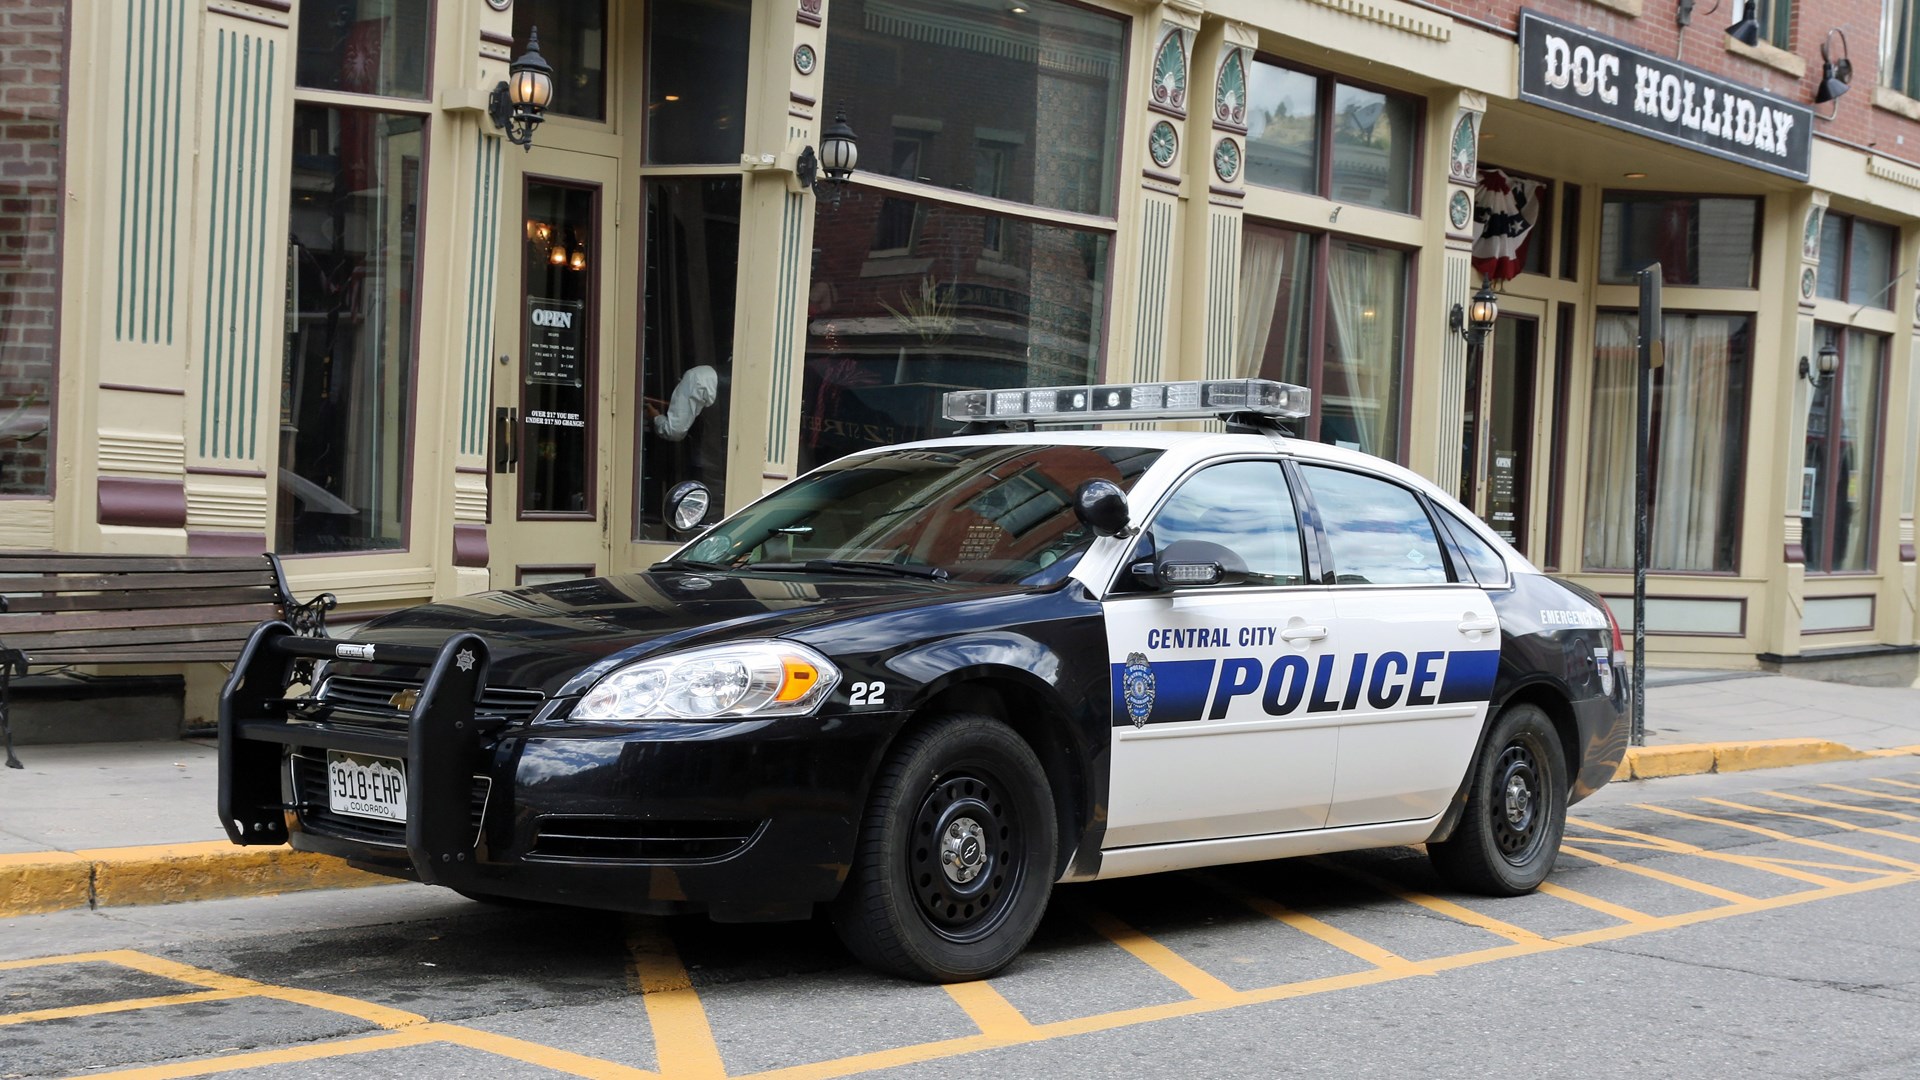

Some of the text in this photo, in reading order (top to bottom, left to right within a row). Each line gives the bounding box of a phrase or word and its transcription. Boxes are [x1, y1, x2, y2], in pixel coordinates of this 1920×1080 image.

[1545, 34, 1794, 157] DOC HOLLIDAY
[532, 308, 572, 328] OPEN
[525, 416, 544, 424] UNDER
[531, 410, 546, 418] OVER
[1540, 609, 1593, 625] EMERGENCY
[1147, 627, 1277, 649] CENTRAL CITY
[1129, 664, 1147, 673] POLICE
[849, 681, 886, 706] 22
[1208, 651, 1445, 720] POLICE
[350, 801, 389, 815] COLORADO
